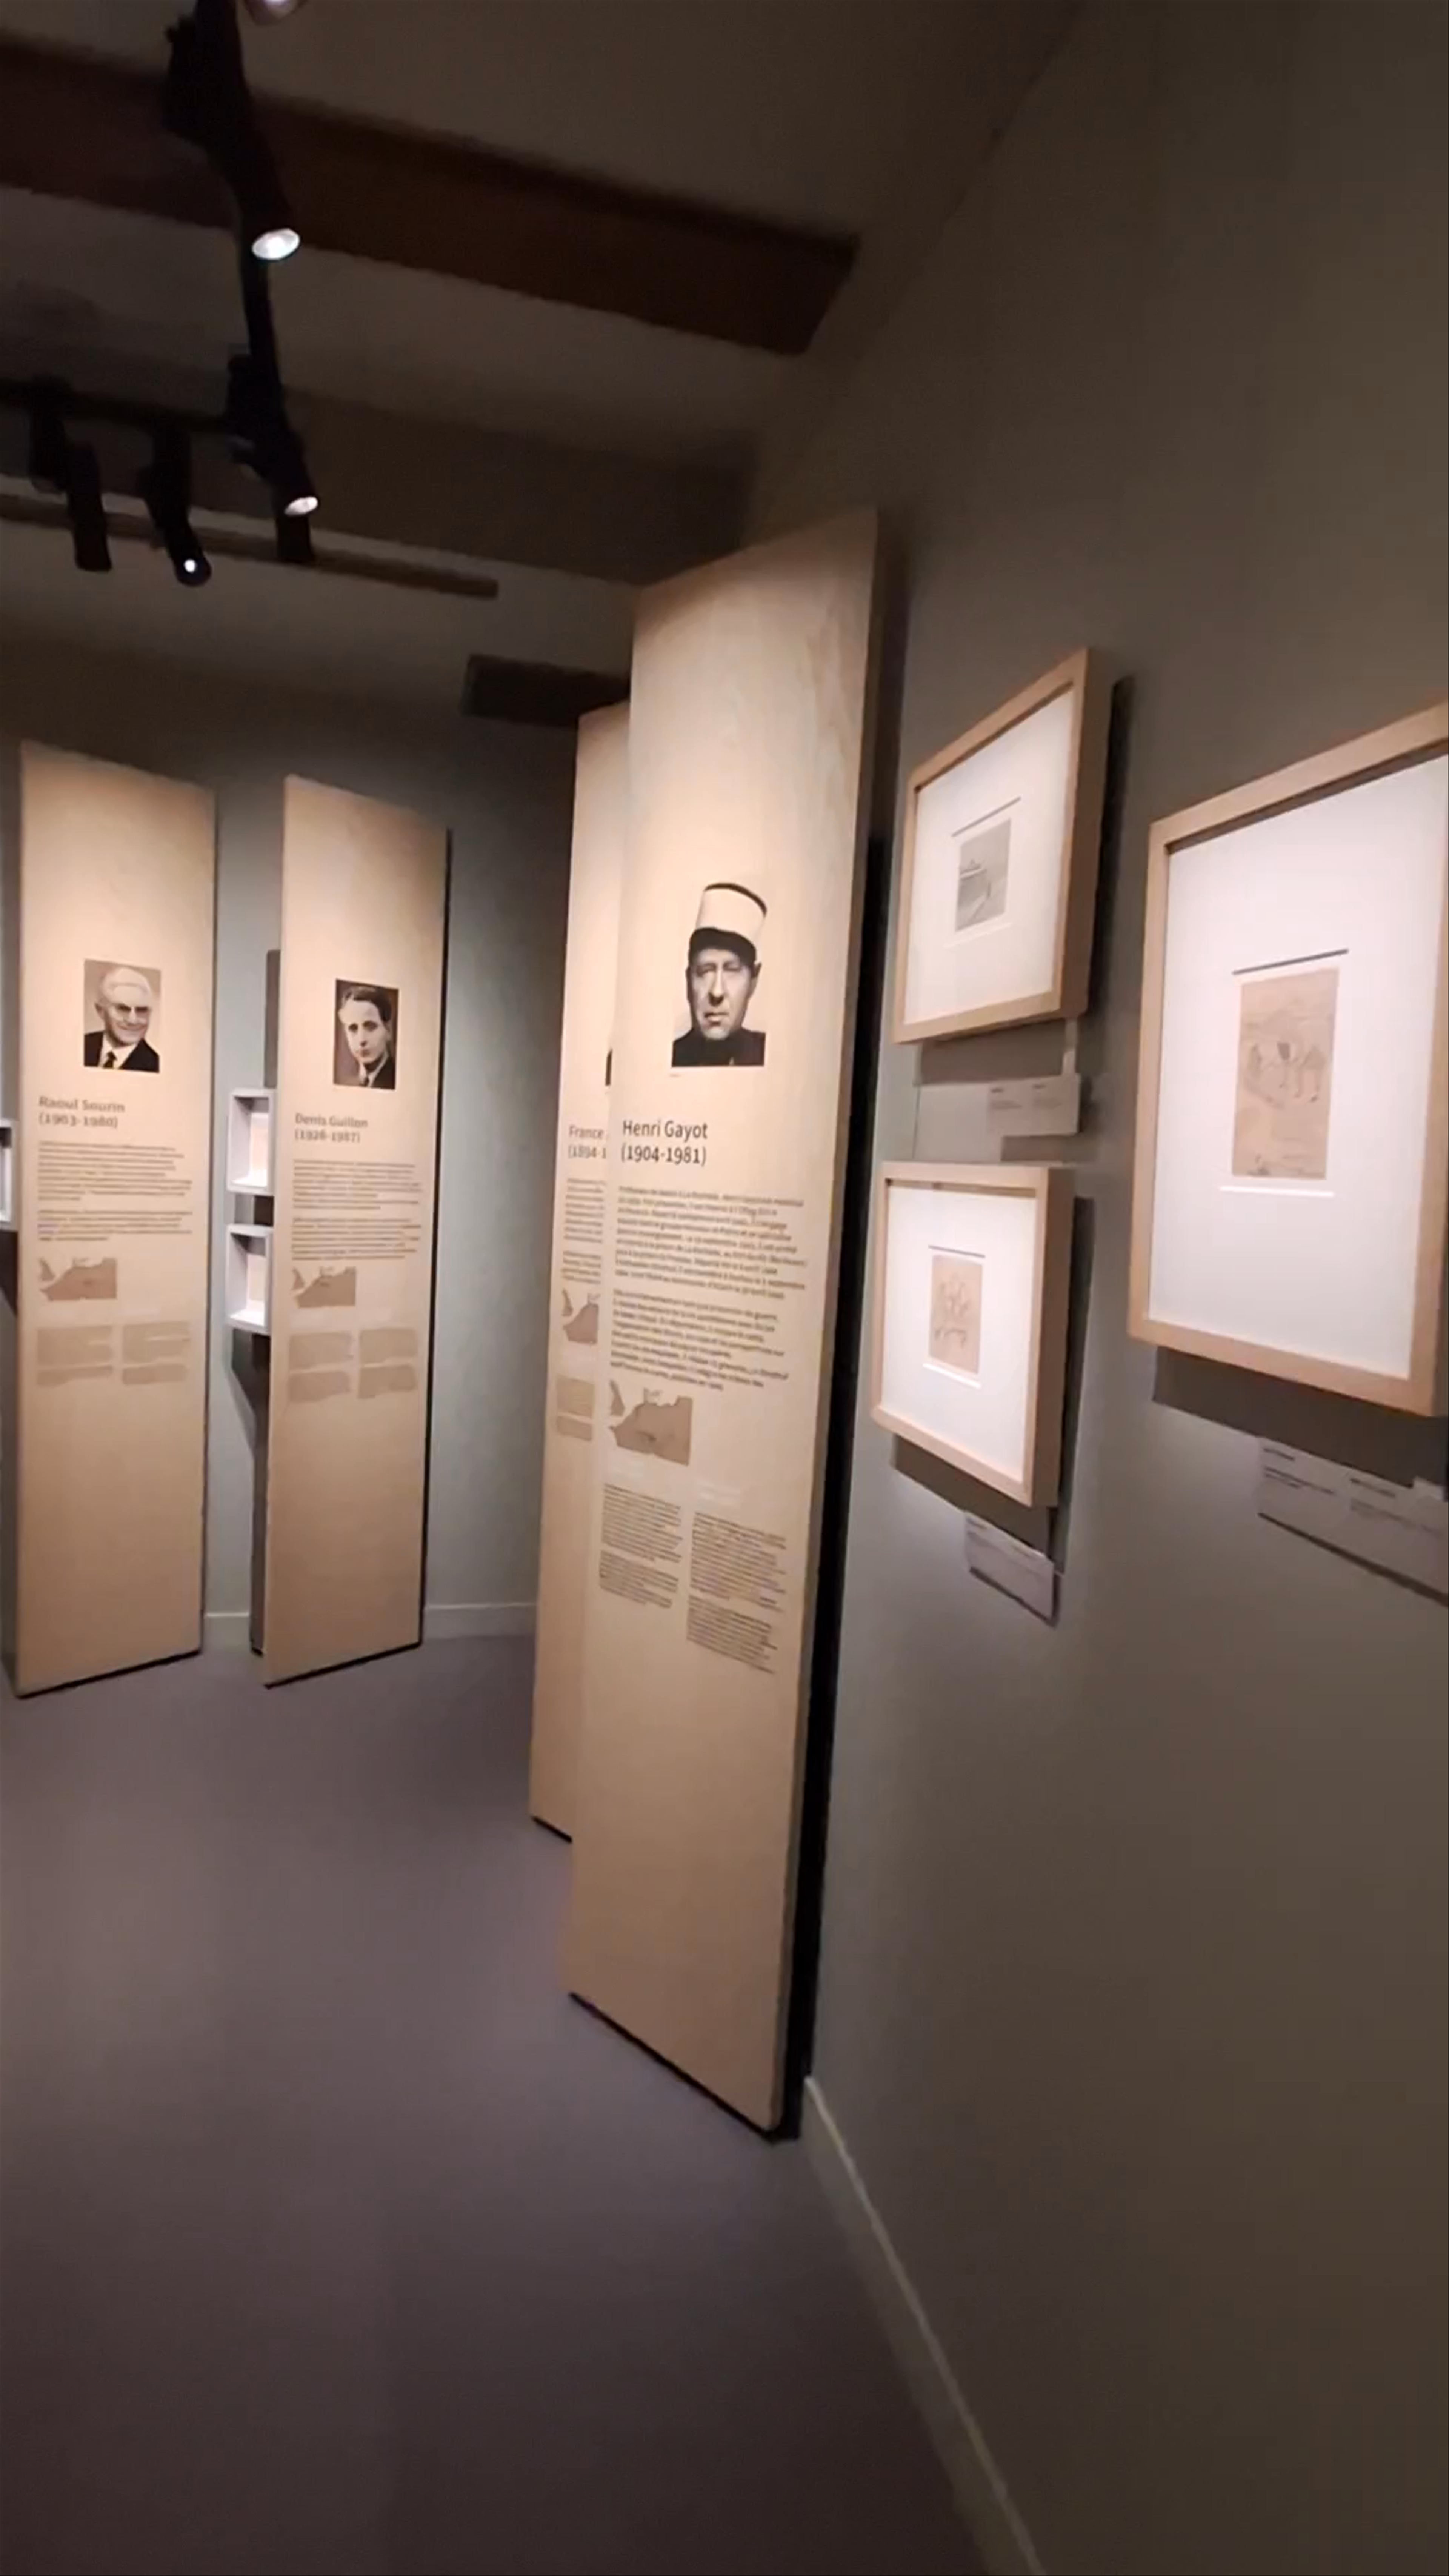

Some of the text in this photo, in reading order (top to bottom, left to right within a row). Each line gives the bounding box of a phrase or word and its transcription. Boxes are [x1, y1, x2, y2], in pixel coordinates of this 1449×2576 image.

[39, 1096, 125, 1113] Raoul Sourin
[295, 1113, 326, 1127] Denis
[569, 1125, 604, 1139] France
[623, 1119, 708, 1143] Henri Gayot
[622, 1143, 706, 1167] (1904-1981)
